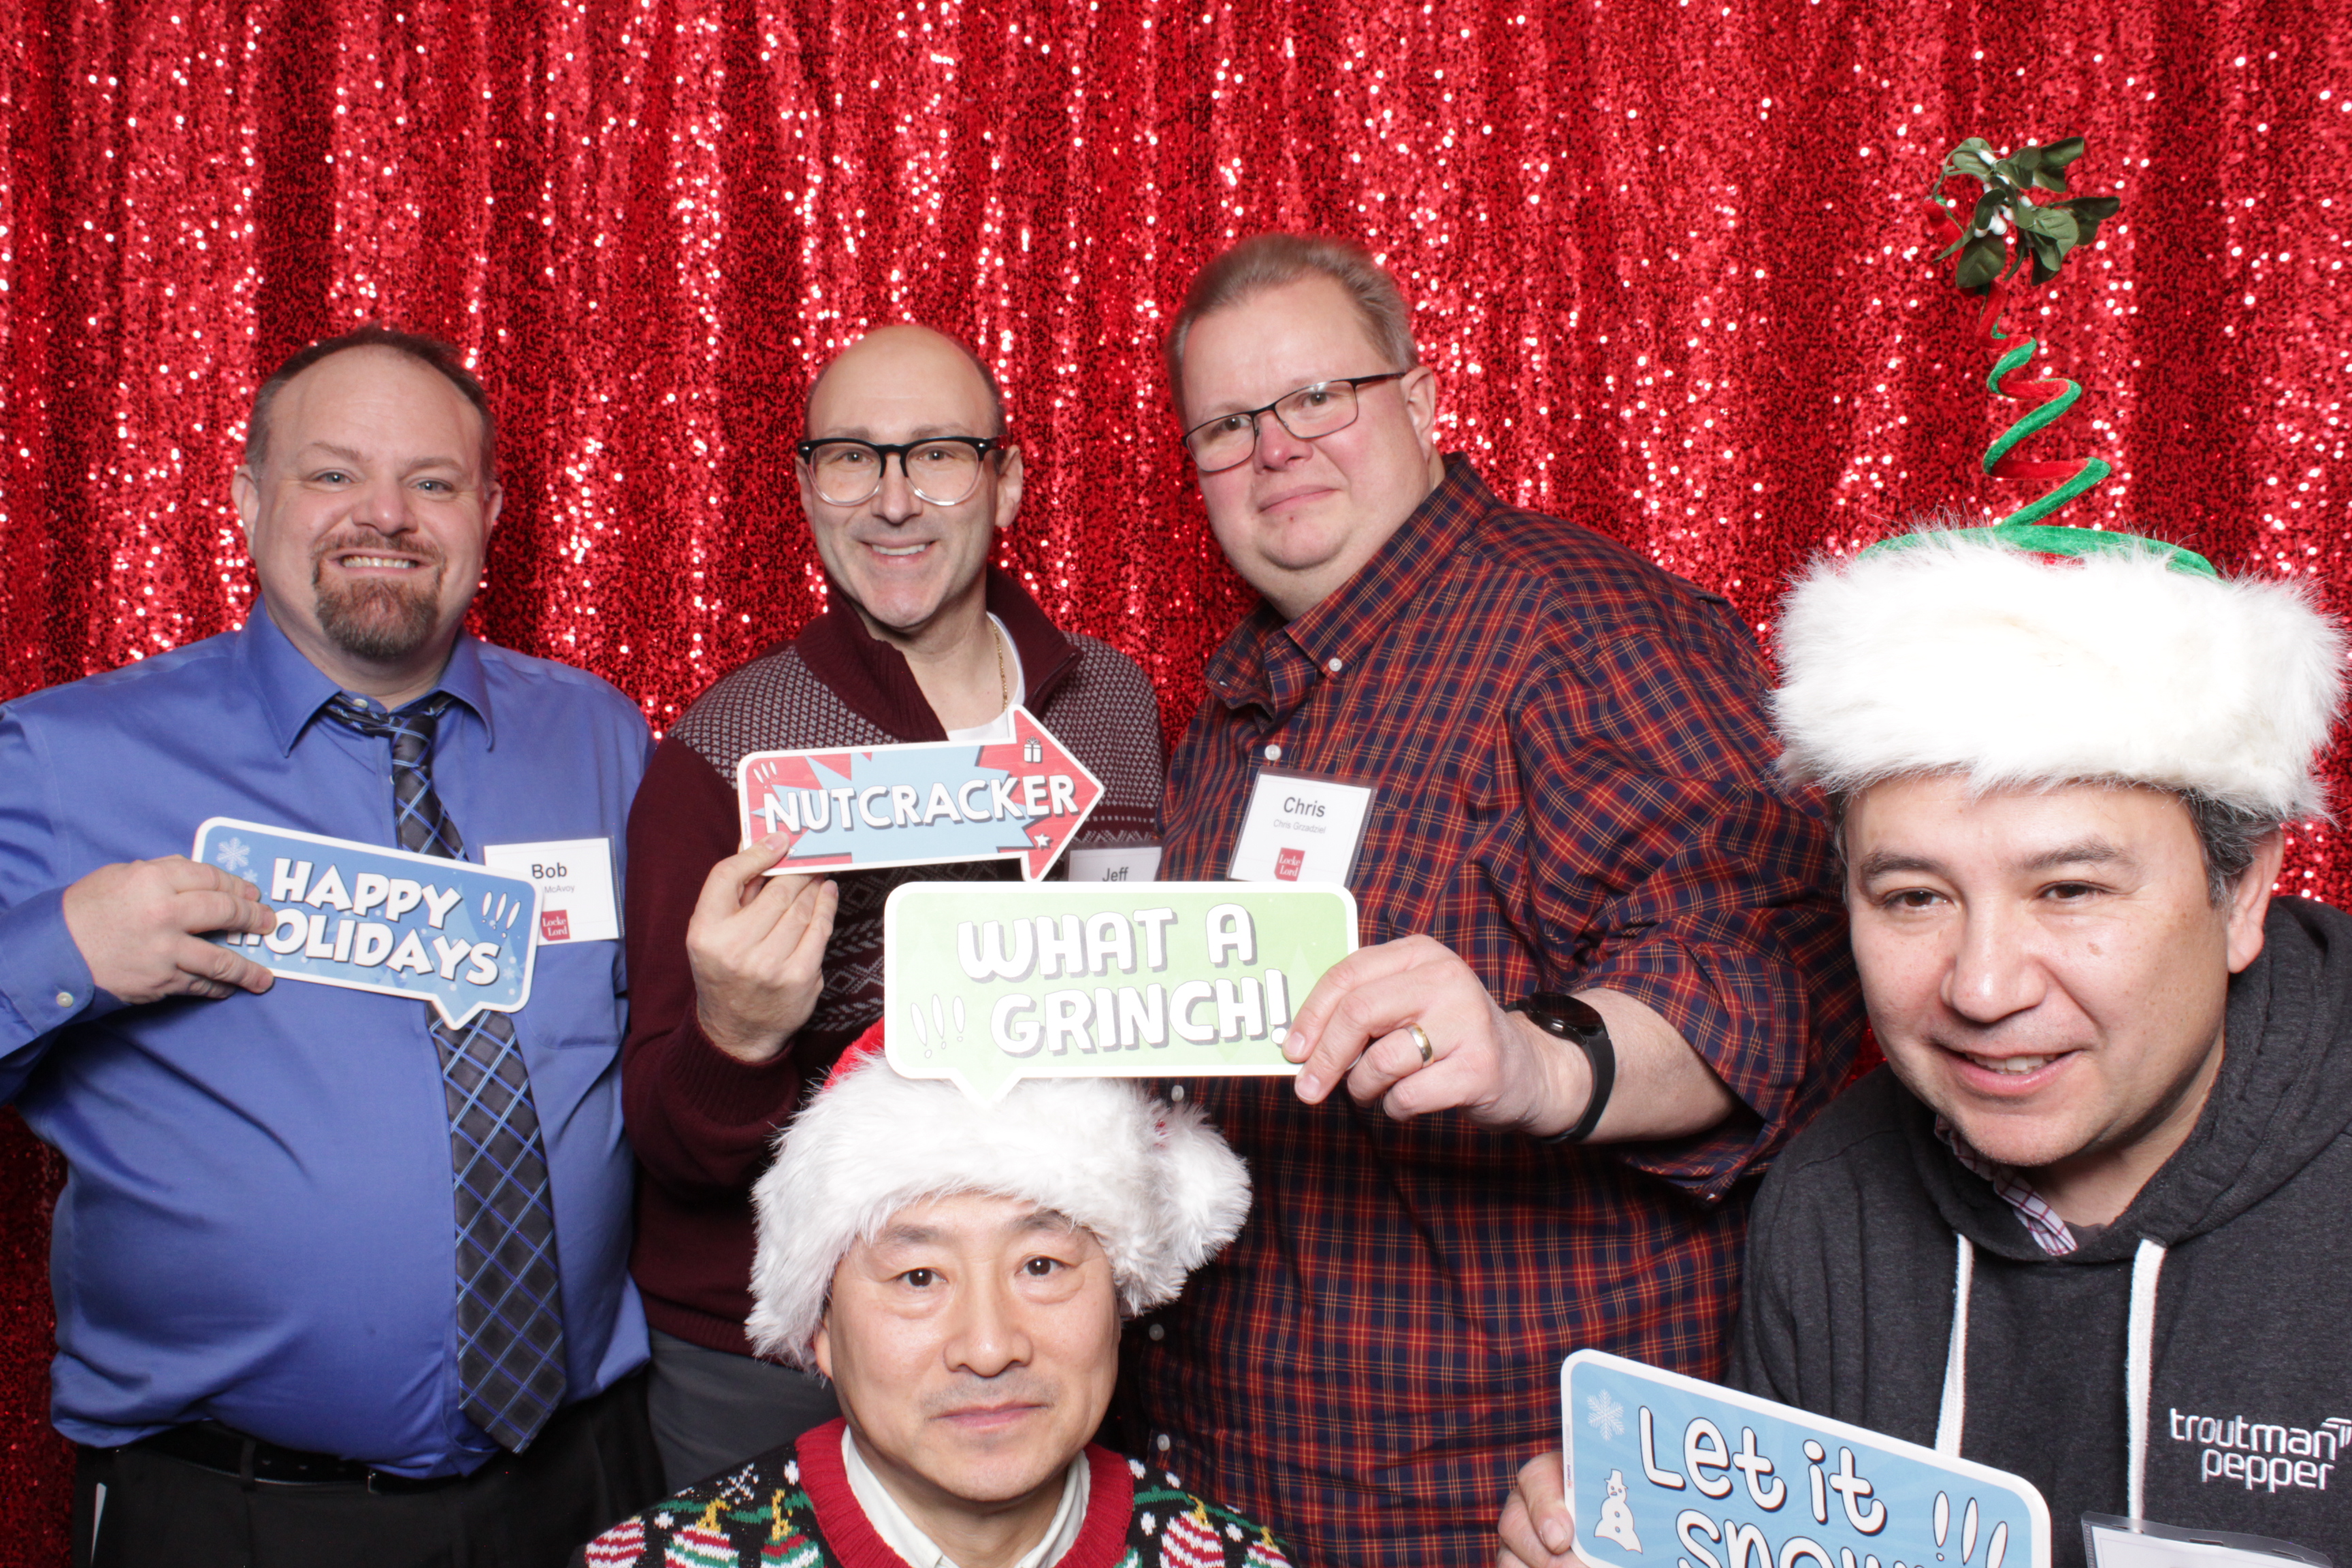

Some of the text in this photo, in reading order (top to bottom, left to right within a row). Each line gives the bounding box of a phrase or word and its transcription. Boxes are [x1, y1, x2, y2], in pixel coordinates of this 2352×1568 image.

[763, 774, 1081, 835] NUTCRACKER
[1284, 796, 1326, 818] Chris
[1273, 819, 1326, 834] Chris Grzadziel
[532, 862, 568, 879] Bob
[1279, 854, 1301, 866] Locke
[1102, 866, 1130, 882] Jeff
[1279, 866, 1298, 877] Lord
[271, 858, 463, 930] HAPPY
[544, 885, 575, 894] McAvoy
[542, 916, 566, 928] Locke
[548, 926, 568, 936] Lord
[226, 908, 501, 987] OLIDAYS
[956, 903, 1258, 983] WHAT A
[990, 968, 1292, 1058] GRINCH!
[2170, 1407, 2336, 1460] troutman
[1638, 1405, 1887, 1536] Let it
[2202, 1448, 2335, 1493] pepper
